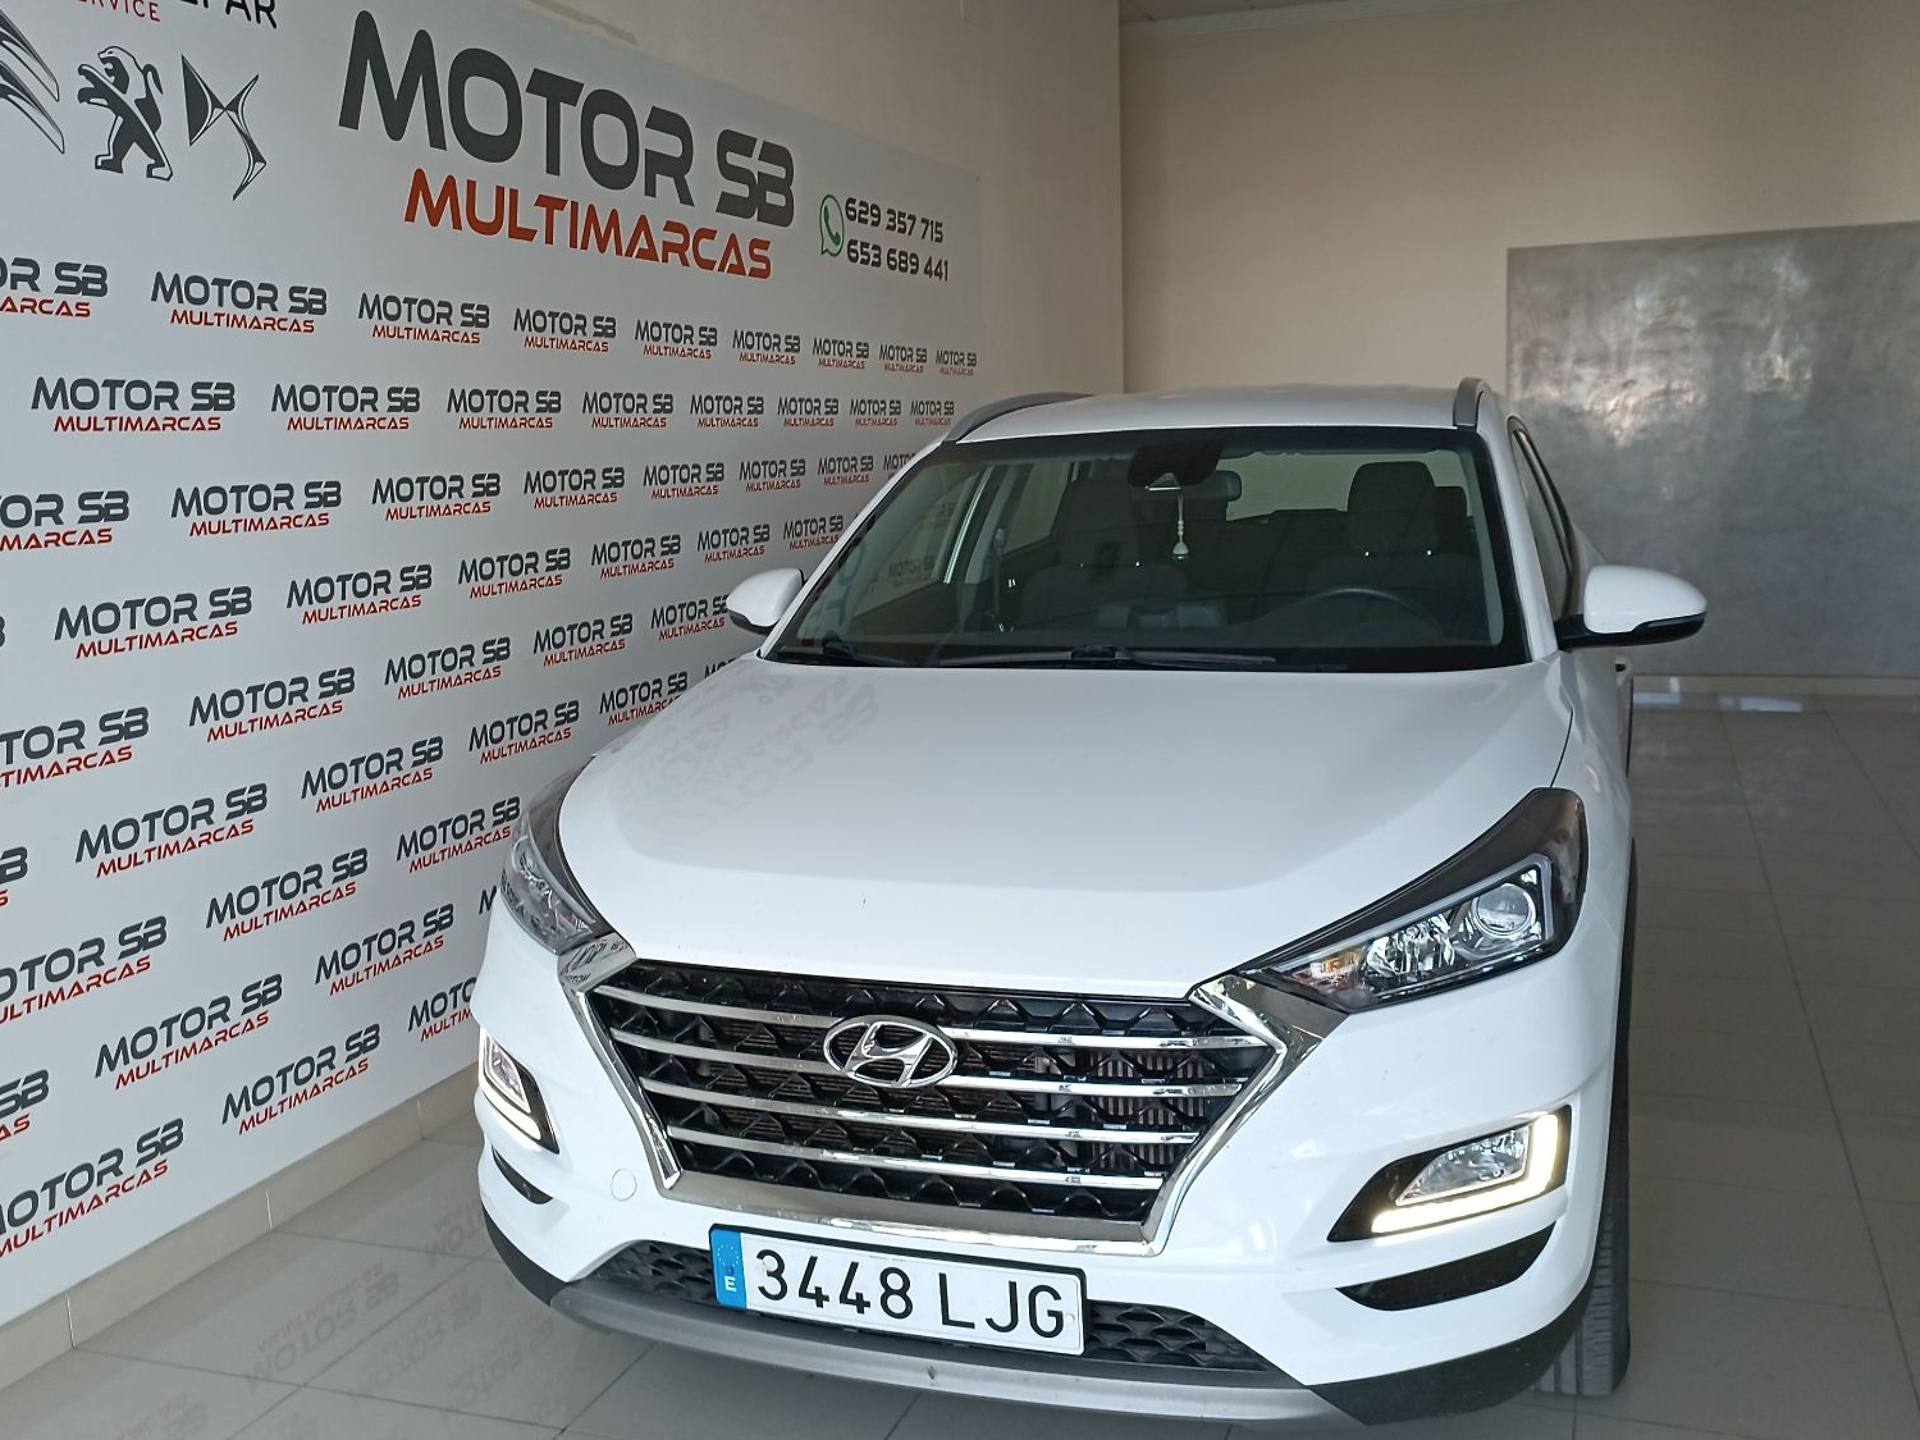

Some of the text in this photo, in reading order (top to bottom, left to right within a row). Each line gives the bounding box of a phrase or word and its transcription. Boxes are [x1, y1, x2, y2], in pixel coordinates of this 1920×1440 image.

[339, 10, 794, 228] MOTOR SB
[404, 168, 771, 279] MULTIMARCAS
[845, 197, 943, 243] 629 357 715
[847, 239, 948, 282] 653 689 441
[54, 262, 108, 297] SB
[151, 272, 326, 315] MOTOR SB
[171, 309, 314, 333] MULTIMARCAS
[358, 293, 489, 328] MOTOR SB
[514, 308, 616, 338] MOTOR SB
[372, 324, 480, 344] MULTIMARCAS
[524, 336, 608, 352] MULTIMARCAS
[635, 320, 717, 346] MOTOR SB
[732, 330, 800, 353] MOTOR SB
[813, 338, 853, 358] MOTOR
[644, 345, 711, 359] MULTIMARCAS
[31, 377, 235, 411] MOTOR SB
[271, 384, 420, 412] MOTOR SB
[447, 388, 561, 413] MOTOR SB
[582, 392, 673, 414] MOTOR SB
[690, 394, 764, 415] MOTOR SB
[778, 397, 821, 415] MOTOR
[54, 416, 220, 432] MULTIMARCAS
[288, 417, 408, 430] MULTIMARCAS
[459, 417, 552, 429] MULTIMARCAS
[592, 417, 666, 428] MULTIMARCAS
[524, 467, 624, 494] MOTOR SB
[644, 462, 724, 486] MOTOR SB
[739, 459, 806, 480] MOTOR SB
[818, 456, 858, 476] MOTOR
[171, 481, 341, 518] MOTOR SB
[372, 473, 500, 504] MOTOR SB
[534, 492, 617, 508] MULTIMARCAS
[652, 485, 718, 499] MULTIMARCAS
[78, 490, 129, 524] SB
[190, 513, 329, 536] MULTIMARCAS
[386, 501, 490, 520] MULTIMARCAS
[0, 528, 112, 551] MARCAS
[698, 524, 770, 551] MOTOR SB
[783, 517, 826, 539] MOTOR
[458, 548, 570, 584] MOTOR SB
[591, 535, 681, 566] MOTOR SB
[600, 558, 674, 578] MULTIMARCAS
[287, 564, 432, 608] MOTOR SB
[470, 574, 562, 598] MULTIMARCAS
[55, 586, 252, 640] MOTOR SB
[302, 594, 421, 624] MULTIMARCAS
[651, 599, 708, 629] MOTOR
[76, 621, 237, 659] MULTIMARCAS
[534, 613, 632, 654] MOTOR SB
[385, 637, 510, 685] MOTOR SB
[544, 638, 625, 666] MULTIMARCAS
[189, 667, 354, 726] MOTOR SB
[398, 666, 501, 699] MULTIMARCAS
[600, 672, 687, 714] MOTOR SB
[0, 707, 148, 765] TOR SB
[207, 700, 342, 742] MULTIMARCAS
[469, 700, 579, 752] MOTOR SB
[480, 727, 571, 764] MULTIMARCAS
[0, 746, 132, 787] TIMARCAS
[302, 736, 443, 799] MOTOR SB
[316, 768, 432, 812] MULTIMARCAS
[76, 783, 267, 863] MOTOR SB
[397, 796, 520, 861] MOTOR SB
[0, 847, 28, 884] B
[97, 819, 253, 878] MULTIMARCAS
[410, 826, 510, 873] MULTIMARCAS
[206, 848, 367, 928] MOTOR SB
[224, 882, 356, 941] MULTIMARCAS
[0, 916, 166, 1002] OTOR SB
[315, 904, 453, 984] MOTOR SB
[330, 935, 443, 996] MULTIMARCAS
[0, 955, 150, 1024] ULTIMARCAS
[408, 977, 477, 1032] MOTO
[95, 974, 282, 1078] MOTOR SB
[116, 1010, 268, 1090] MULTIMARCAS
[222, 1024, 380, 1124] MOTOR SB
[239, 1058, 368, 1134] MULTIMARCAS
[136, 1118, 183, 1168] SB
[724, 1275, 737, 1293] E
[756, 1249, 1065, 1338] 3448 LJG
